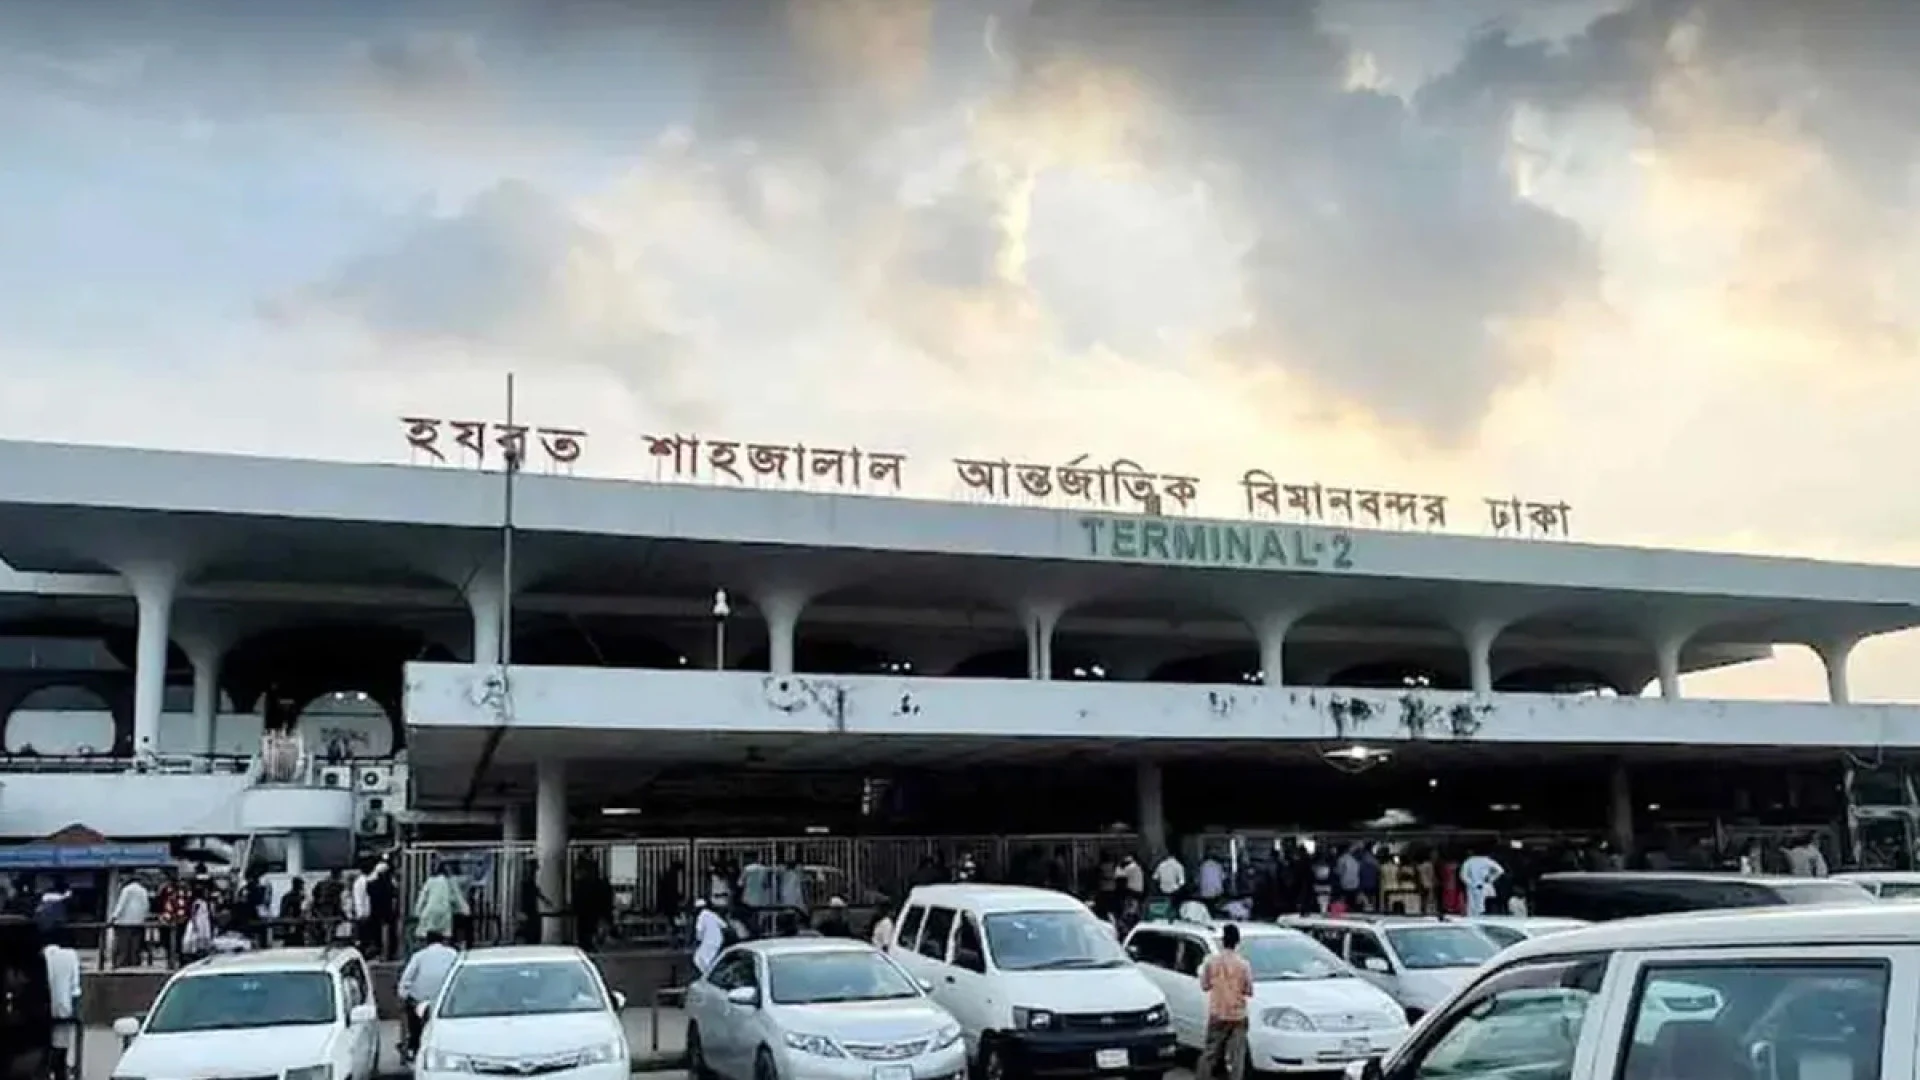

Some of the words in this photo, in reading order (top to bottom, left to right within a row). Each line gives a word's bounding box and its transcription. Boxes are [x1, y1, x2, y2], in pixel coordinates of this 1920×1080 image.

[399, 417, 588, 470] হযরত
[641, 432, 907, 489] শাহজালাল
[952, 453, 1200, 510] আন্তর্জাতিক
[1240, 469, 1448, 527] বিমানবন্দর
[1483, 494, 1571, 536] ঢাকা
